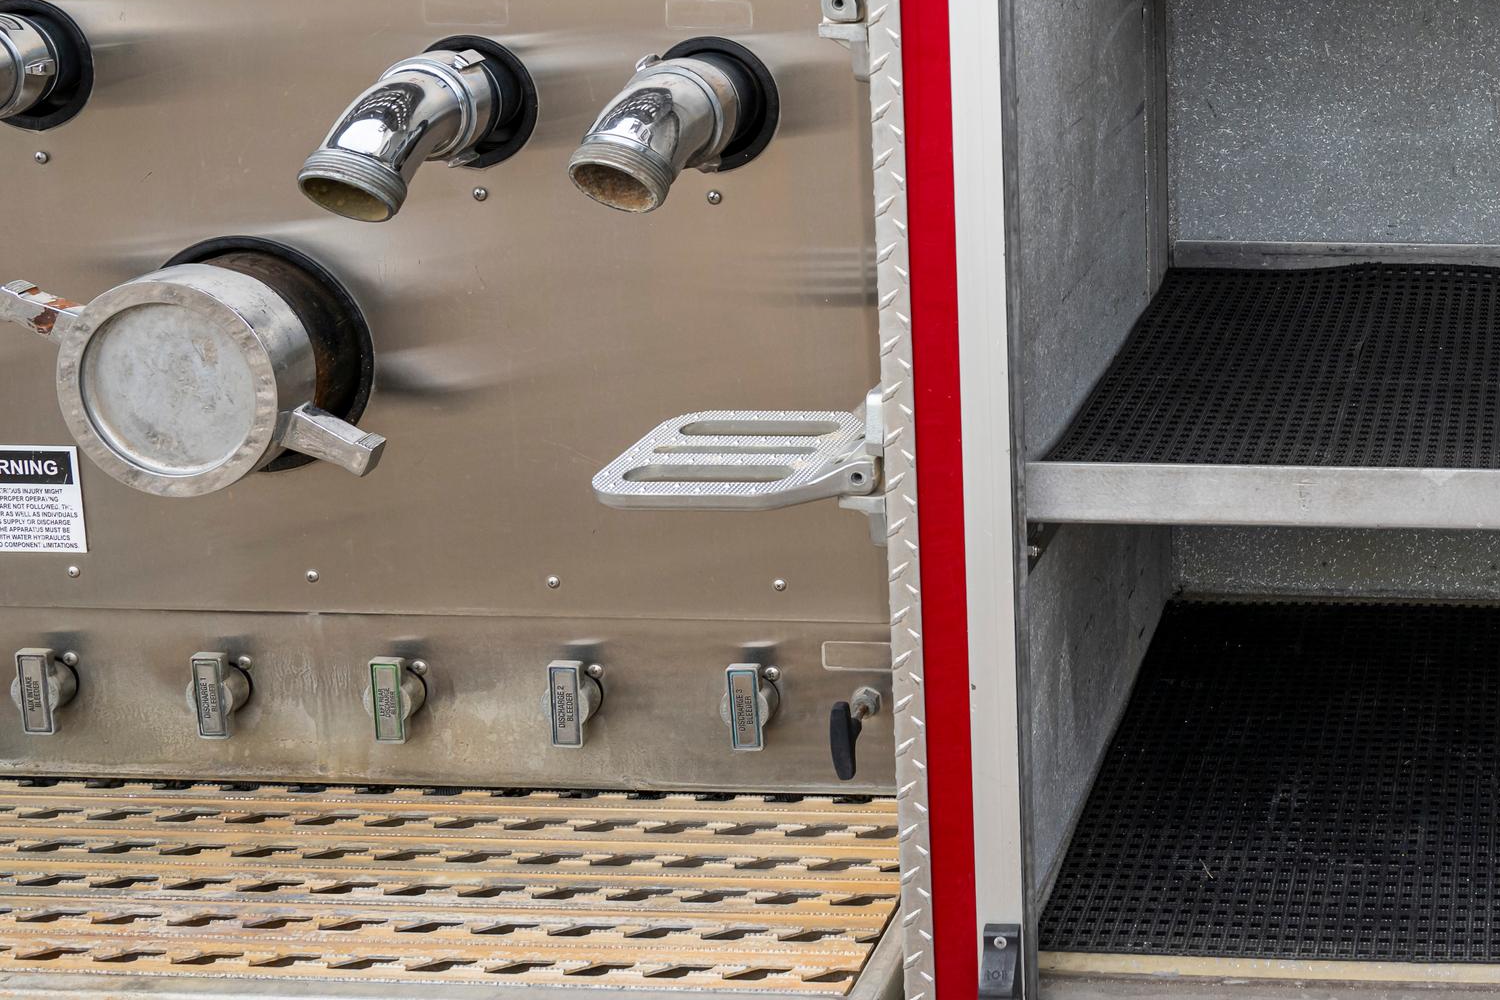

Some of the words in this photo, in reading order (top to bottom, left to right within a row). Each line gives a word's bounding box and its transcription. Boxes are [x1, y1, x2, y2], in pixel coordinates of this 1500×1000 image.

[0, 460, 58, 475] RNING
[25, 676, 34, 698] INTAKE
[33, 680, 41, 708] BLEEDER
[200, 682, 211, 719] DISCHARGE
[208, 683, 217, 712] BLEEDER
[557, 691, 566, 728] DISCHARGE
[565, 692, 574, 722] BLEEDER
[736, 694, 746, 732] DISCHARGE
[745, 695, 754, 725] BLEEDER
